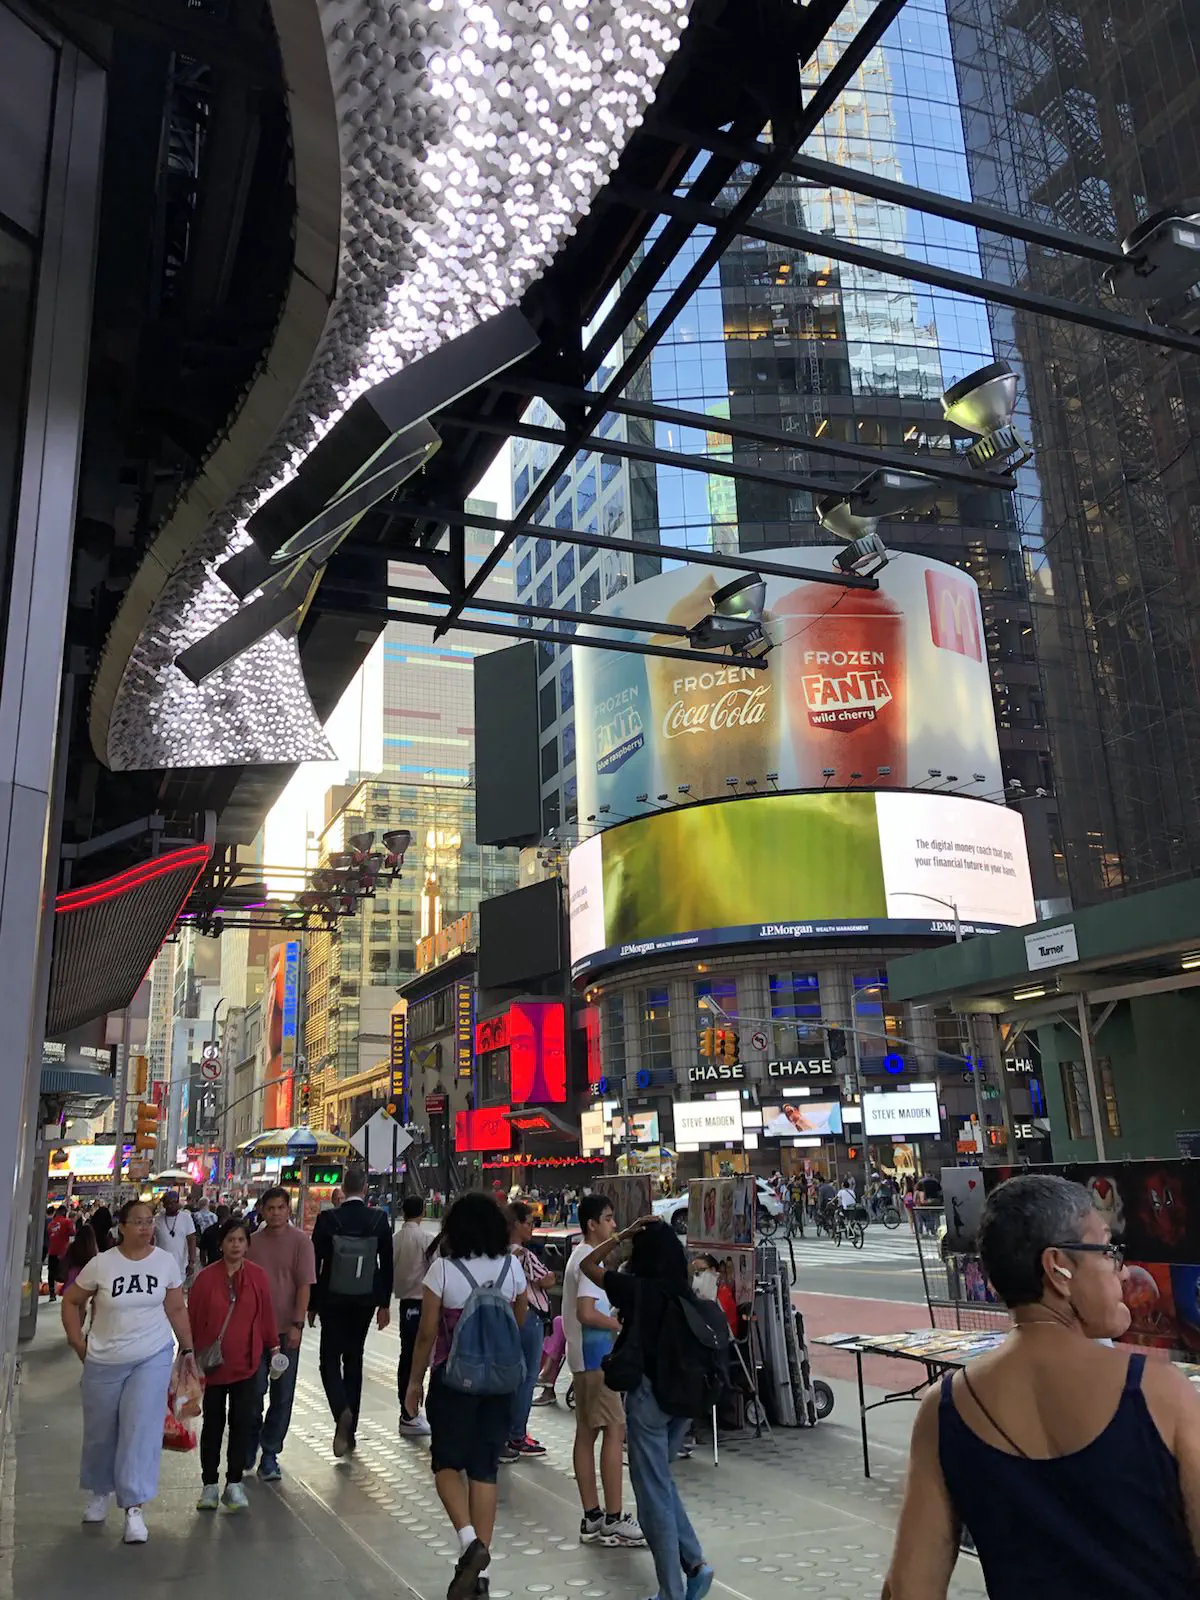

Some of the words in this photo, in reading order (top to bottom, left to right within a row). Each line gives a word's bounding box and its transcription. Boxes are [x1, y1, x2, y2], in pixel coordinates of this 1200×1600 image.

[803, 650, 885, 666] FROZEN
[673, 666, 756, 695] FROZEN
[803, 671, 891, 706] FANTA
[592, 684, 639, 717] FROZEN
[662, 684, 772, 739] Coca-Cola
[812, 712, 836, 724] wild
[838, 709, 875, 720] cherry
[609, 737, 643, 763] raspberry
[916, 838, 930, 849] The
[931, 839, 954, 852] digital
[954, 842, 976, 855] money
[975, 845, 992, 856] coach
[914, 857, 931, 868] your
[933, 856, 963, 869] financial
[963, 859, 983, 871] future
[983, 862, 990, 871] in
[990, 864, 1002, 875] your
[760, 923, 813, 937] J.P.Morgan
[930, 921, 974, 936] J.P.Mogan
[1038, 944, 1064, 957] Turner
[459, 984, 470, 1040] VICTORY
[393, 1016, 403, 1064] VICTORY
[459, 1049, 470, 1076] NEW
[768, 1060, 833, 1076] CHASE
[688, 1064, 744, 1081] CHASE
[393, 1071, 403, 1095] NEW
[681, 1118, 702, 1128] STEVE
[705, 1116, 735, 1127] MADDEN
[871, 1108, 896, 1120] STEVE
[898, 1107, 932, 1119] MADDEN
[111, 1274, 158, 1298] GAP
